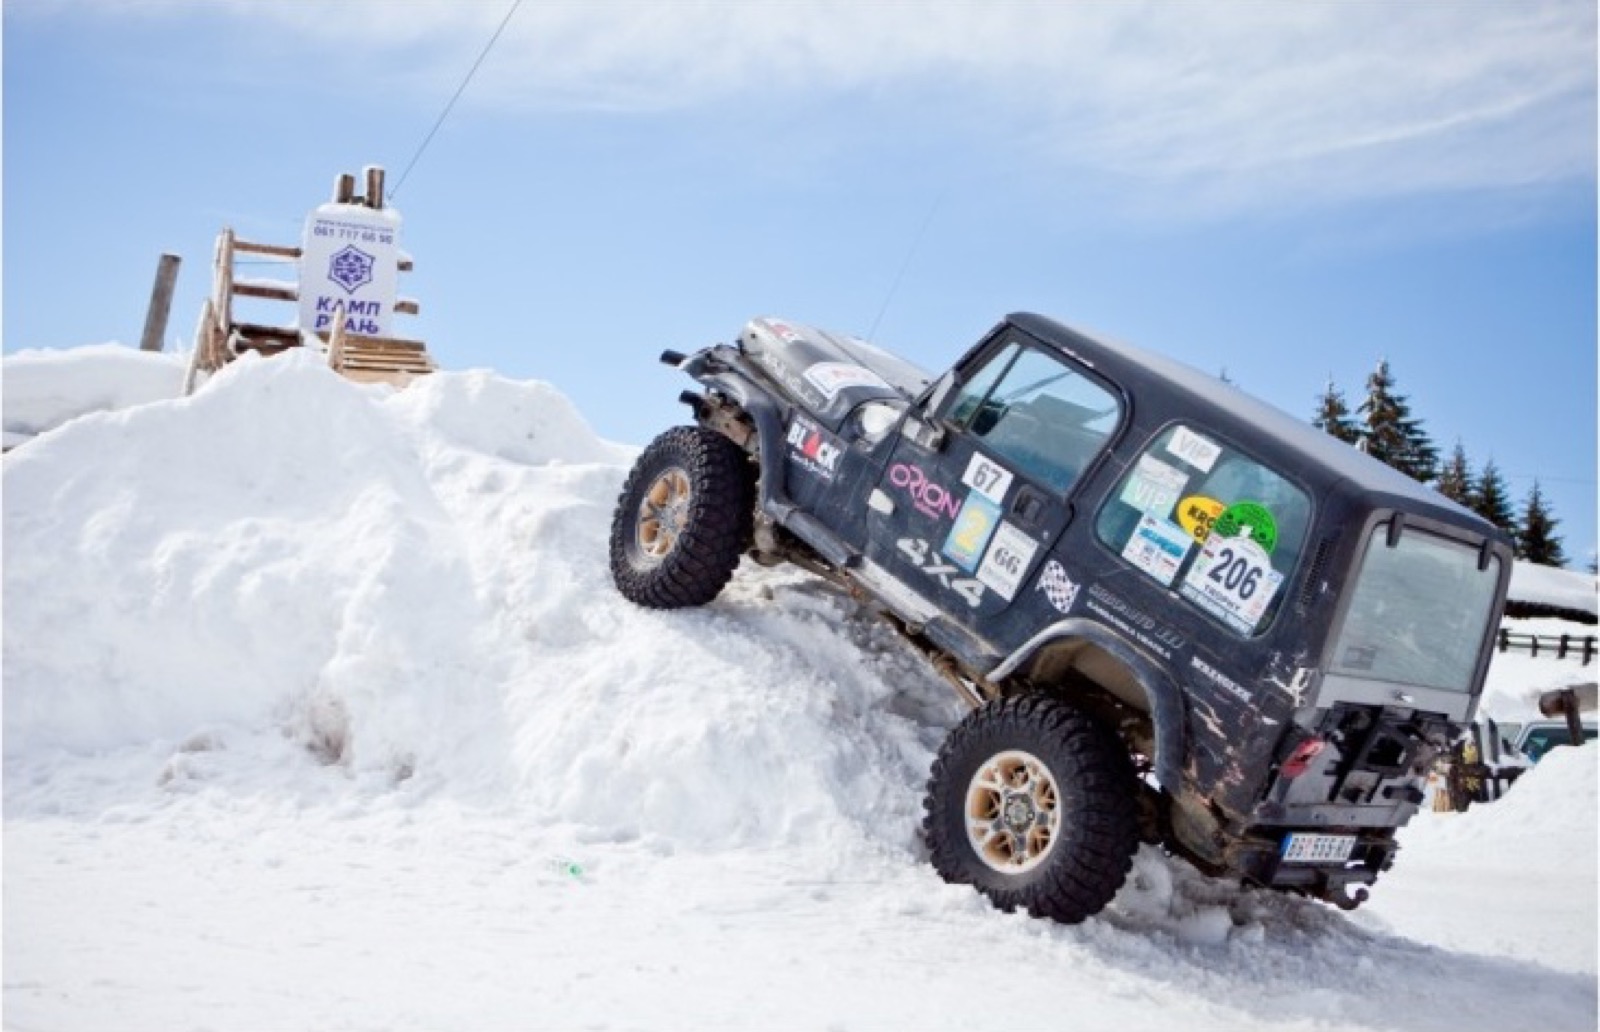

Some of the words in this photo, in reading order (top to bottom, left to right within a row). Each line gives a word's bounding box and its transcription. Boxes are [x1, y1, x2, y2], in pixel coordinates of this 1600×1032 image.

[339, 229, 359, 240] 717
[315, 313, 379, 334] РАЊ
[787, 420, 841, 470] BLACK
[1179, 432, 1211, 459] VIP
[890, 464, 961, 519] ORION
[973, 463, 1003, 493] 67
[1134, 480, 1168, 508] VIP
[955, 508, 988, 554] 2
[993, 548, 1021, 575] 66
[1208, 548, 1263, 600] 206
[1204, 584, 1241, 611] TROPHY
